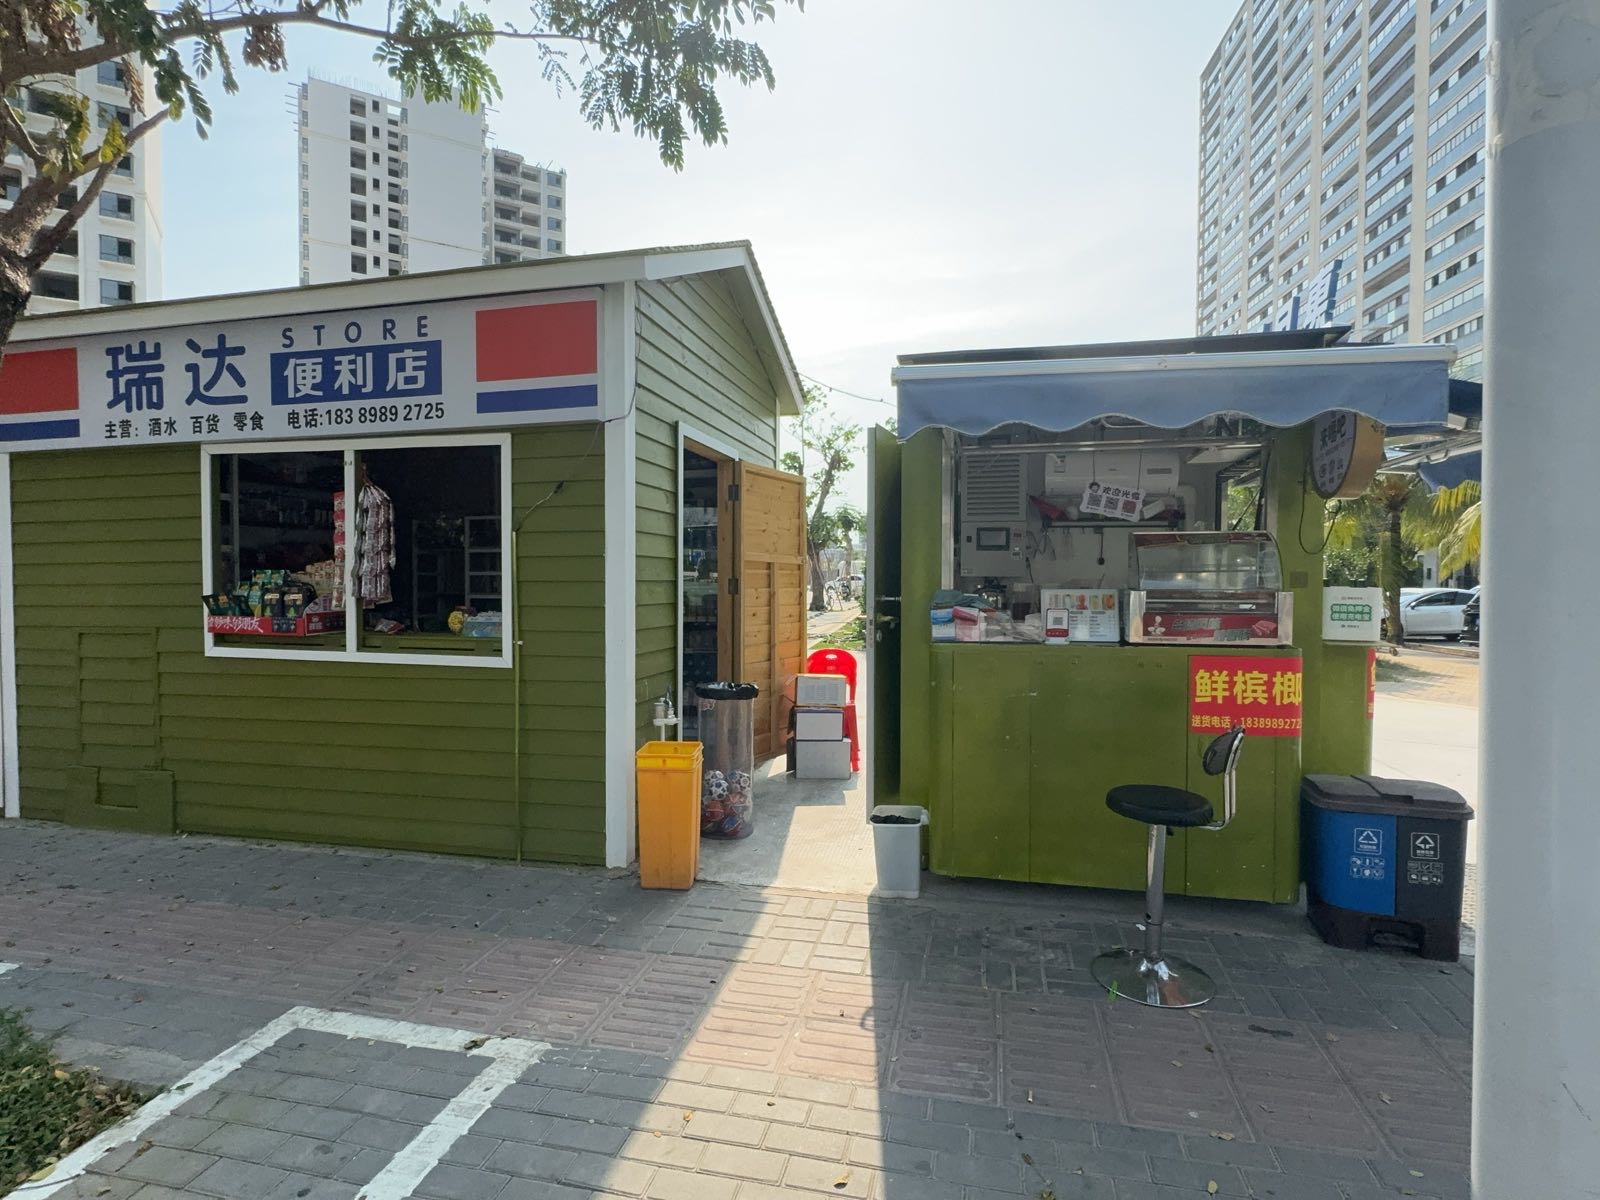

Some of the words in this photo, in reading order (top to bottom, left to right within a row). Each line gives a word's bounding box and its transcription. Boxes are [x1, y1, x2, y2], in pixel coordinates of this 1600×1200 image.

[281, 315, 429, 349] STORE
[105, 333, 248, 413] 瑞达
[283, 349, 428, 399] 便利店
[148, 417, 178, 437] 酒水
[190, 413, 220, 434] 百货
[233, 410, 264, 431] 零食
[358, 405, 399, 424] 8989
[403, 402, 445, 421] 2725
[1194, 669, 1302, 706] 鲜槟榔
